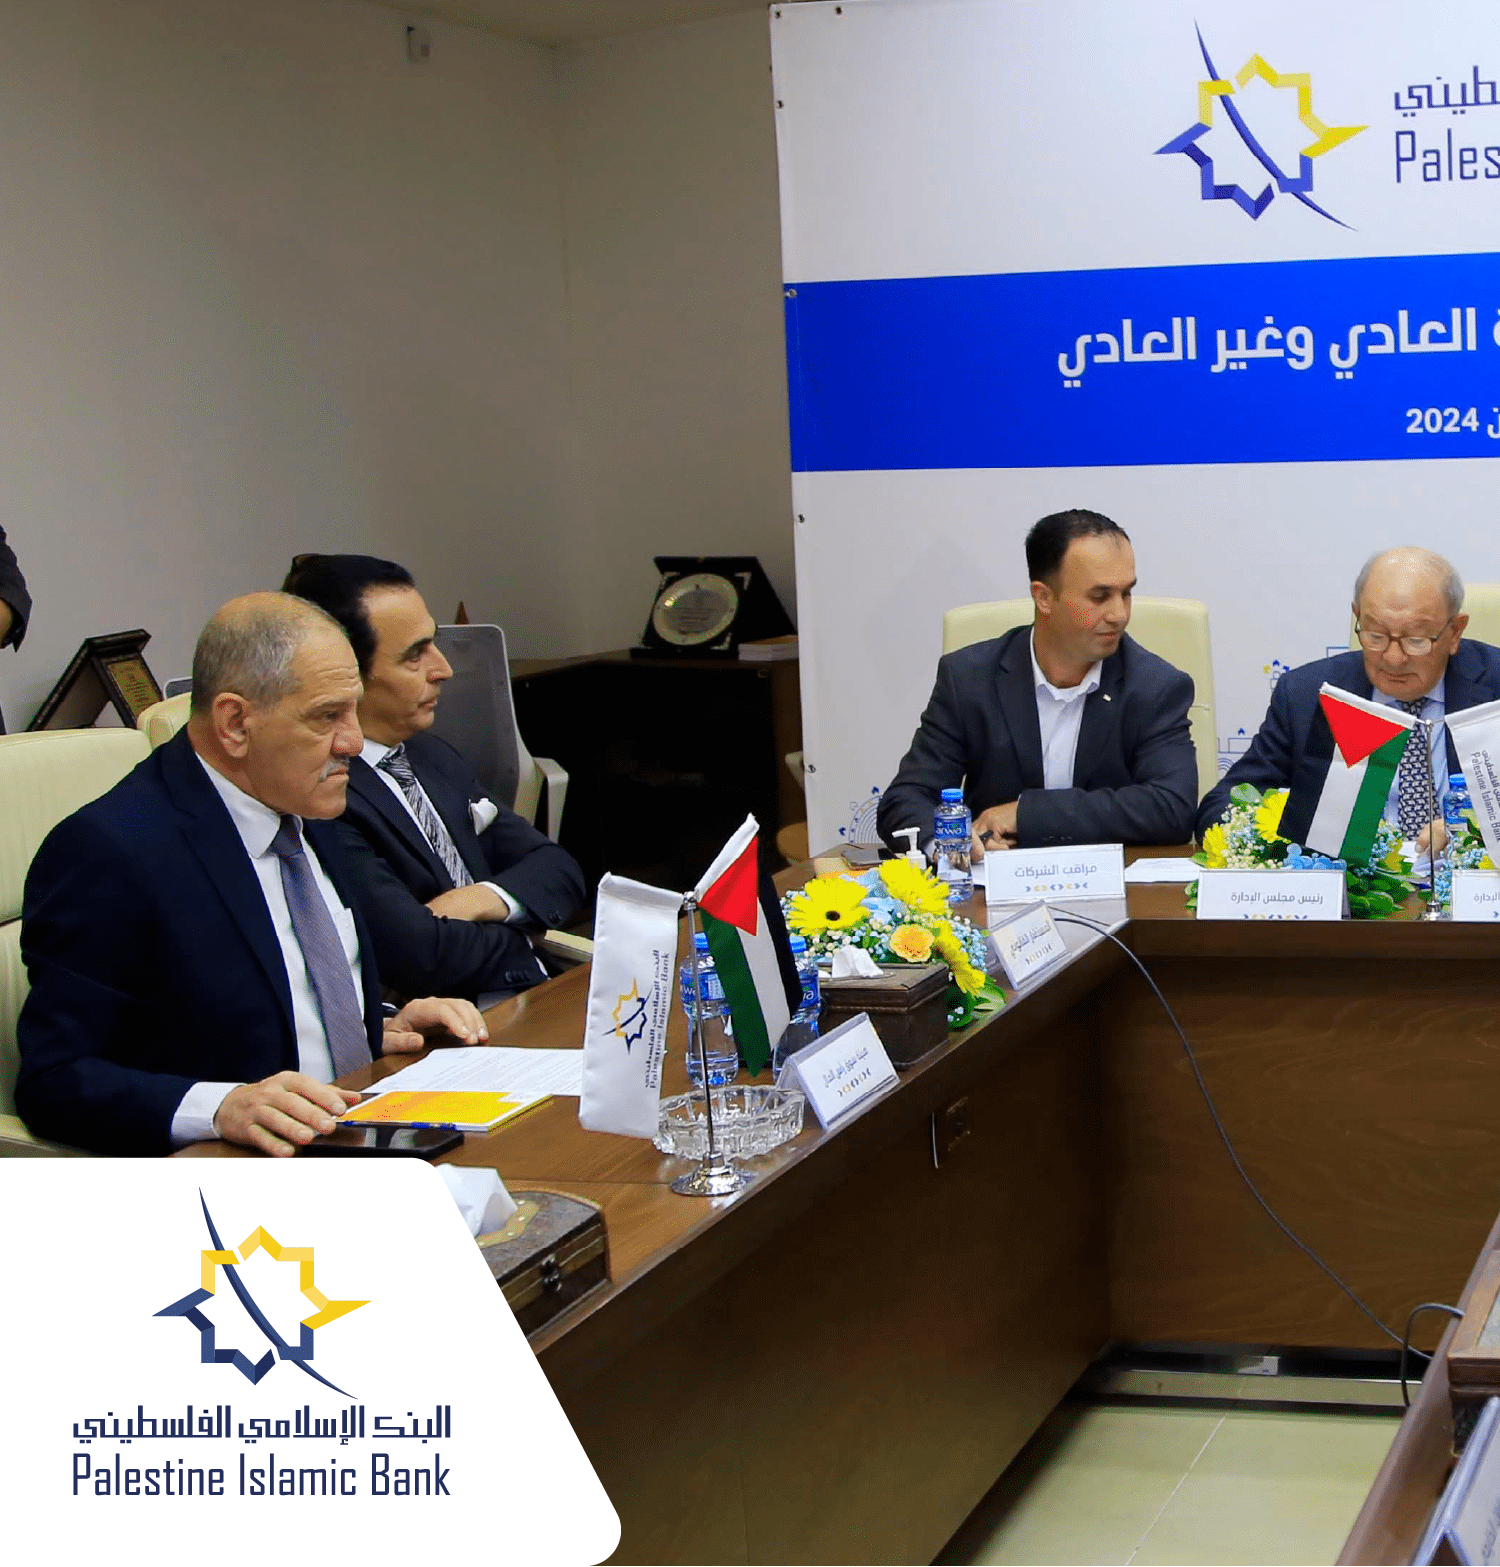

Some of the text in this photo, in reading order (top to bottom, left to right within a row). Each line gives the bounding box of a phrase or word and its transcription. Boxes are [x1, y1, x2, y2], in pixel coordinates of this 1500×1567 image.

[1057, 315, 1198, 388] العادي
[1210, 315, 1315, 374] وغير
[1329, 306, 1478, 380] العادي
[1405, 407, 1480, 435] 2024
[1470, 751, 1487, 791] Palestine
[1481, 790, 1496, 821] Islamic
[1014, 863, 1098, 880] مراقب الشركات
[1262, 891, 1296, 905] مجلس
[1297, 892, 1324, 905] رئيس
[660, 951, 670, 983] Bank
